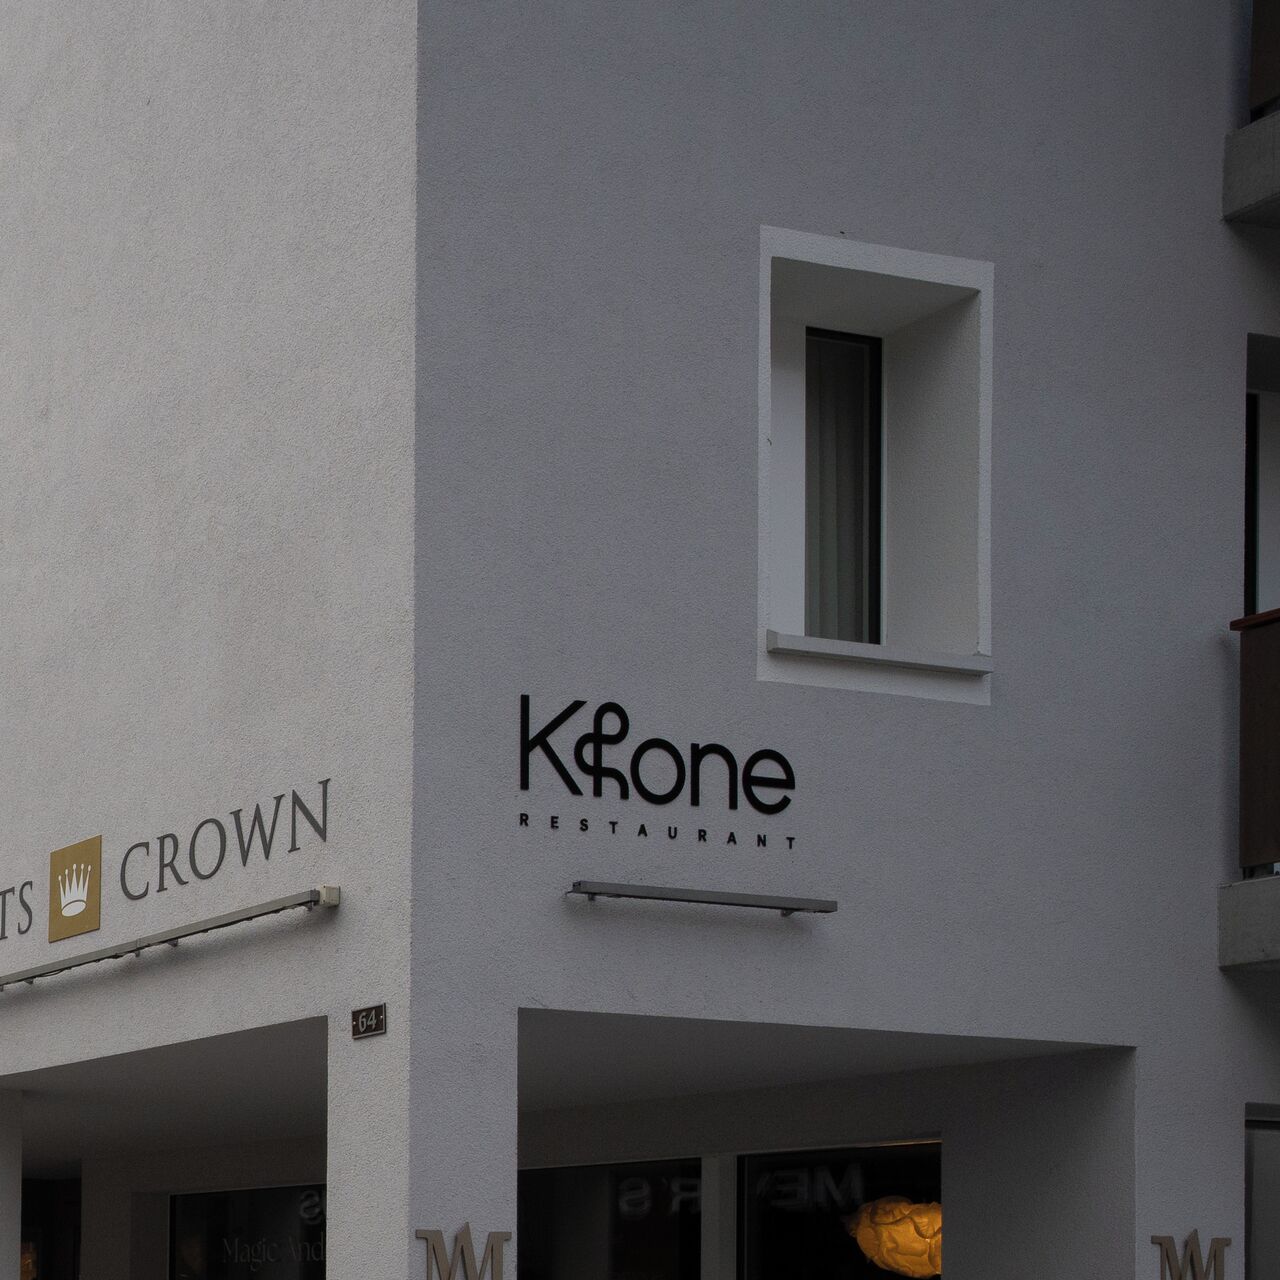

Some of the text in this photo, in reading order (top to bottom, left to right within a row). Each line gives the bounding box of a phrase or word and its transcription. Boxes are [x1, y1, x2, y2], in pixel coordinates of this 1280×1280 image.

[119, 776, 331, 903] CROWN
[520, 812, 796, 850] RESTAURANT
[358, 1009, 377, 1033] 64
[221, 1237, 280, 1272] Magic
